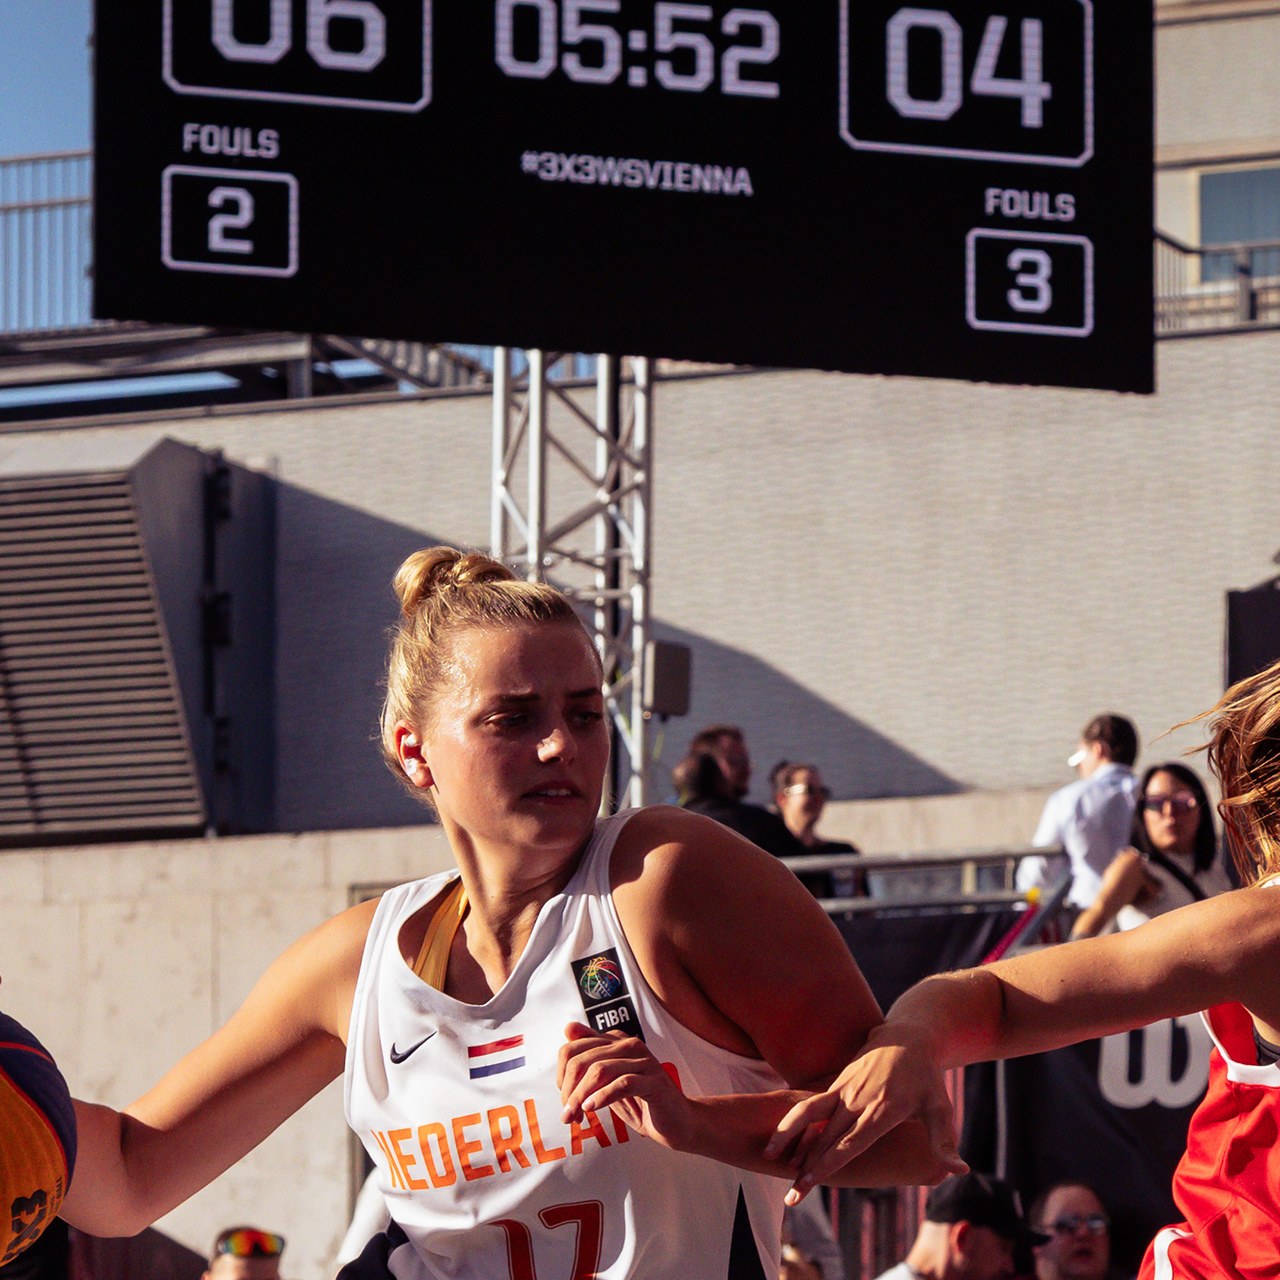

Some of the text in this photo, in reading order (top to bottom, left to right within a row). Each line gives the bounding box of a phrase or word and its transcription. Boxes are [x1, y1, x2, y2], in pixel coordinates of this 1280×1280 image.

[494, 0, 780, 97] 05:52
[884, 5, 1052, 129] 04
[183, 123, 280, 161] FOULS
[520, 150, 753, 198] #3X3WSVIENNA
[206, 186, 255, 255] 2
[984, 188, 1076, 223] FOULS
[1005, 248, 1053, 314] 3
[595, 1006, 631, 1031] FIBA
[370, 1098, 632, 1191] NEDERLA
